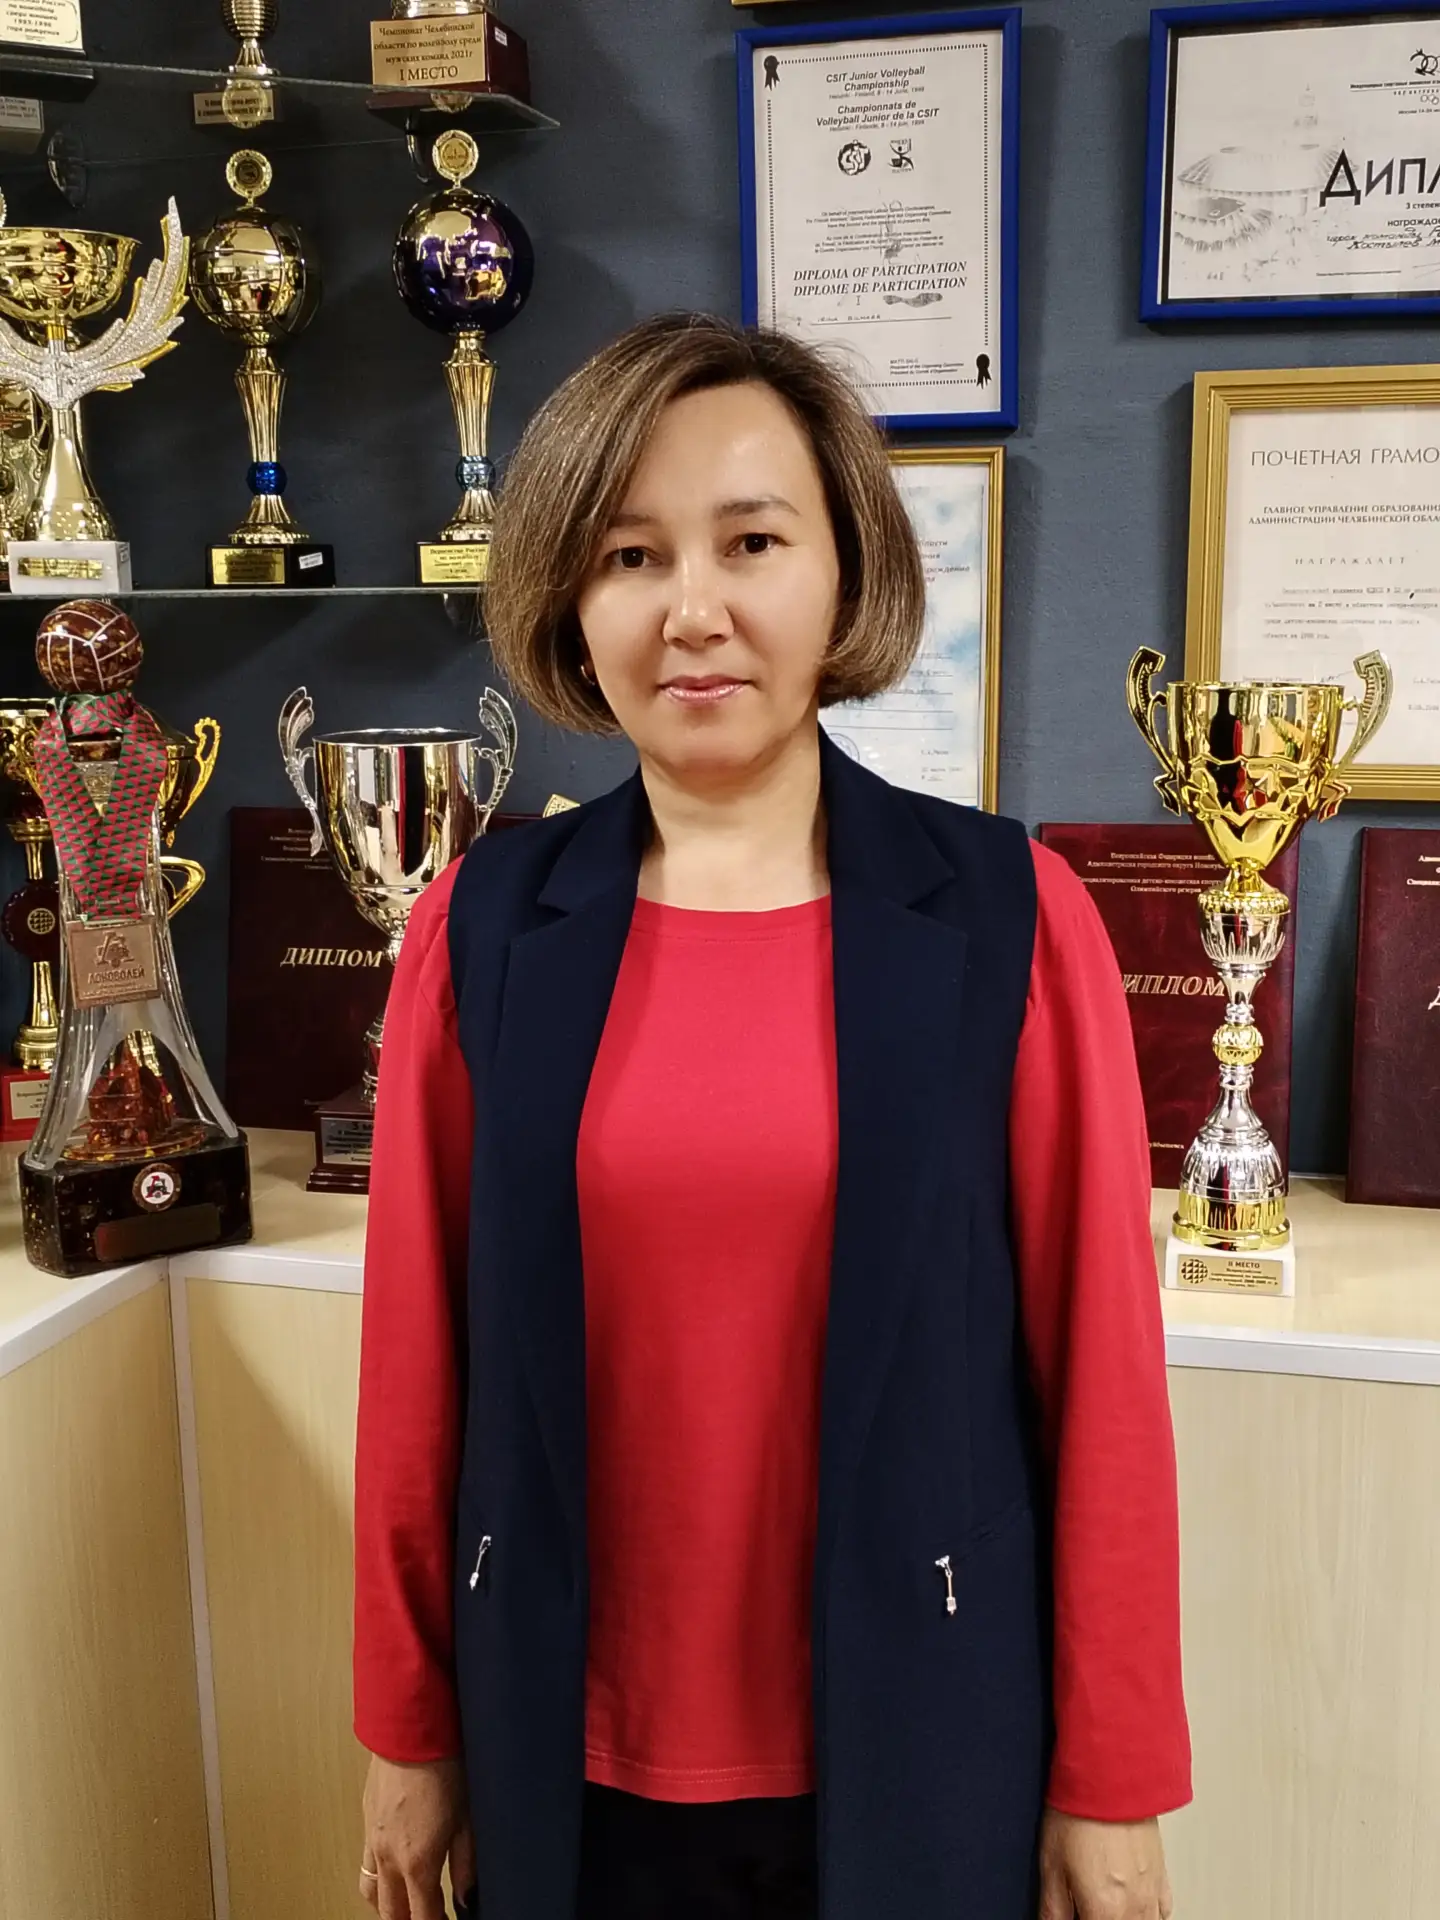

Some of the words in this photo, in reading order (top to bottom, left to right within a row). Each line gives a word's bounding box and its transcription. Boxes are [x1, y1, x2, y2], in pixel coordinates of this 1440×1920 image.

[379, 27, 423, 36] Чемпионат
[424, 22, 475, 34] Челябинской
[374, 41, 406, 50] области
[407, 41, 417, 49] по
[419, 39, 458, 48] волейболу
[460, 37, 482, 46] среди
[386, 55, 420, 65] мужских
[422, 53, 450, 61] команд
[408, 65, 459, 81] МЕСТО
[826, 73, 848, 83] CSIT
[850, 71, 878, 81] Junior
[881, 66, 926, 78] Volleyball
[845, 79, 910, 92] Championship
[838, 101, 903, 115] Championnats
[905, 100, 917, 109] de
[817, 116, 860, 127] Volleyball
[862, 113, 890, 123] Junior
[893, 112, 905, 120] de
[907, 110, 915, 119] la
[917, 108, 940, 118] CSIT
[794, 268, 849, 281] DIPLOMA
[853, 267, 870, 278] OF
[872, 261, 967, 277] PARTICIPATION
[794, 283, 849, 297] DIPLOME
[853, 282, 869, 294] DE
[872, 277, 967, 293] PARTICIPATION
[1251, 449, 1361, 467] ПОЧЕТНАЯ
[1371, 447, 1440, 464] ГРАМО
[1264, 506, 1305, 514] ГЛАВНОЕ
[1308, 505, 1369, 514] УПРАВЛЕНИЕ
[1249, 516, 1336, 525] АДМИНИСТРАЦИИ
[1338, 515, 1411, 524] ЧЕЛЯБИНСКОЙ
[1295, 557, 1405, 566] НАГРАЖДАЕТ
[280, 948, 383, 968] ДИПЛОМ
[1122, 974, 1225, 997] ИПЛОМ
[1235, 1261, 1261, 1269] МЕСТО
